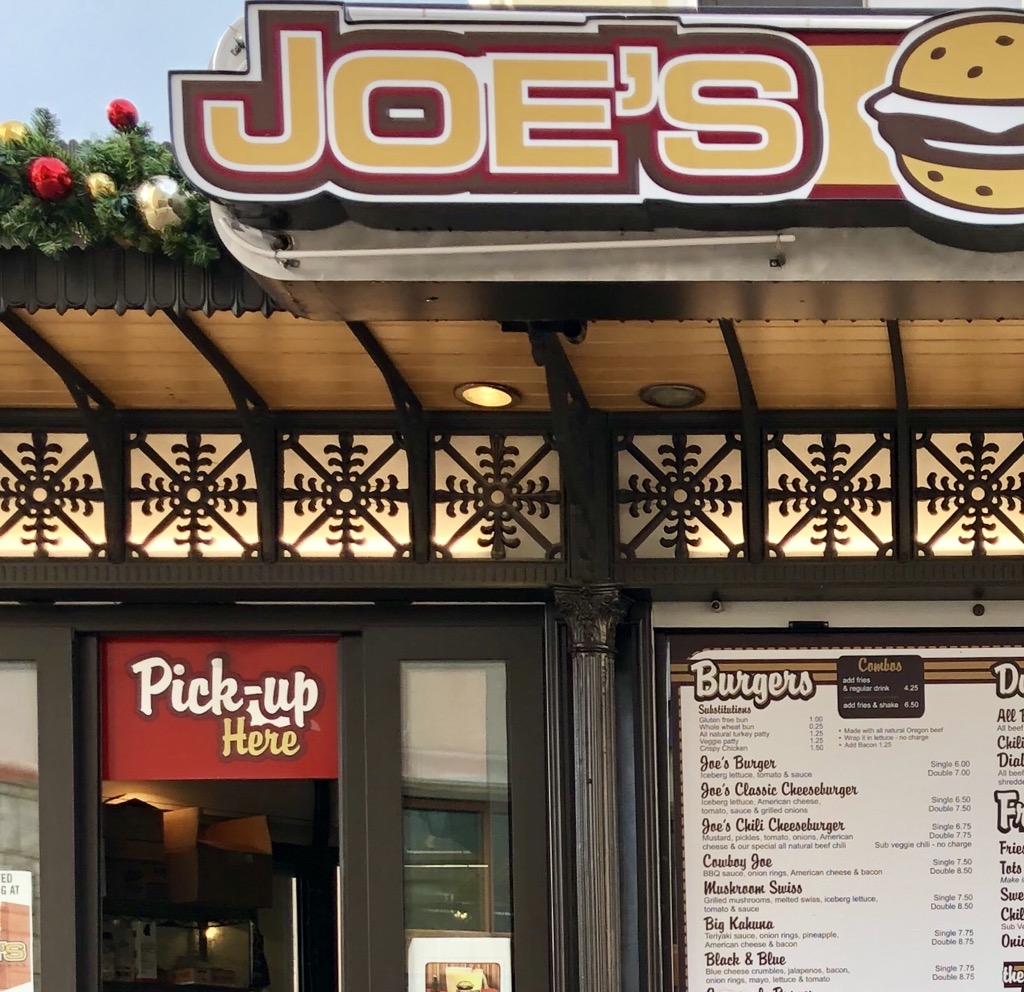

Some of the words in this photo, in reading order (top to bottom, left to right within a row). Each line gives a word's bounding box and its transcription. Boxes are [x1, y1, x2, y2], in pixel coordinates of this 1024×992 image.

[203, 30, 804, 176] JOE'S
[858, 658, 902, 673] Combos
[690, 659, 814, 706] Burgers
[856, 676, 871, 684] fries
[131, 657, 319, 728] Pick-up
[849, 685, 872, 693] regular
[698, 705, 751, 715] Substitutions
[997, 708, 1017, 723] All
[222, 716, 300, 757] Here
[997, 735, 1024, 749] Chili
[700, 755, 730, 771] Joe's
[733, 755, 777, 771] Burger
[928, 769, 953, 777] Double
[701, 782, 730, 798] Joe's
[735, 782, 778, 797] Classic
[782, 782, 858, 798] Cheeseburger
[931, 796, 954, 804] Single
[702, 818, 731, 833] Joe's
[736, 818, 764, 832] Chili
[769, 818, 846, 833] Cheeseburger
[932, 823, 954, 831] Single
[703, 854, 747, 869] Cowboy
[751, 854, 773, 869] Joe
[1000, 861, 1022, 875] Tots
[766, 870, 789, 878] rings,
[930, 867, 955, 875] Double
[10, 885, 20, 895] AT
[704, 881, 765, 895] Mushroom
[769, 881, 803, 894] Swiss
[704, 917, 725, 933] Big
[729, 916, 775, 930] Kahuna
[705, 952, 741, 967] Black
[745, 952, 753, 965] &
[757, 952, 787, 965] Blue
[1002, 966, 1024, 984] the
